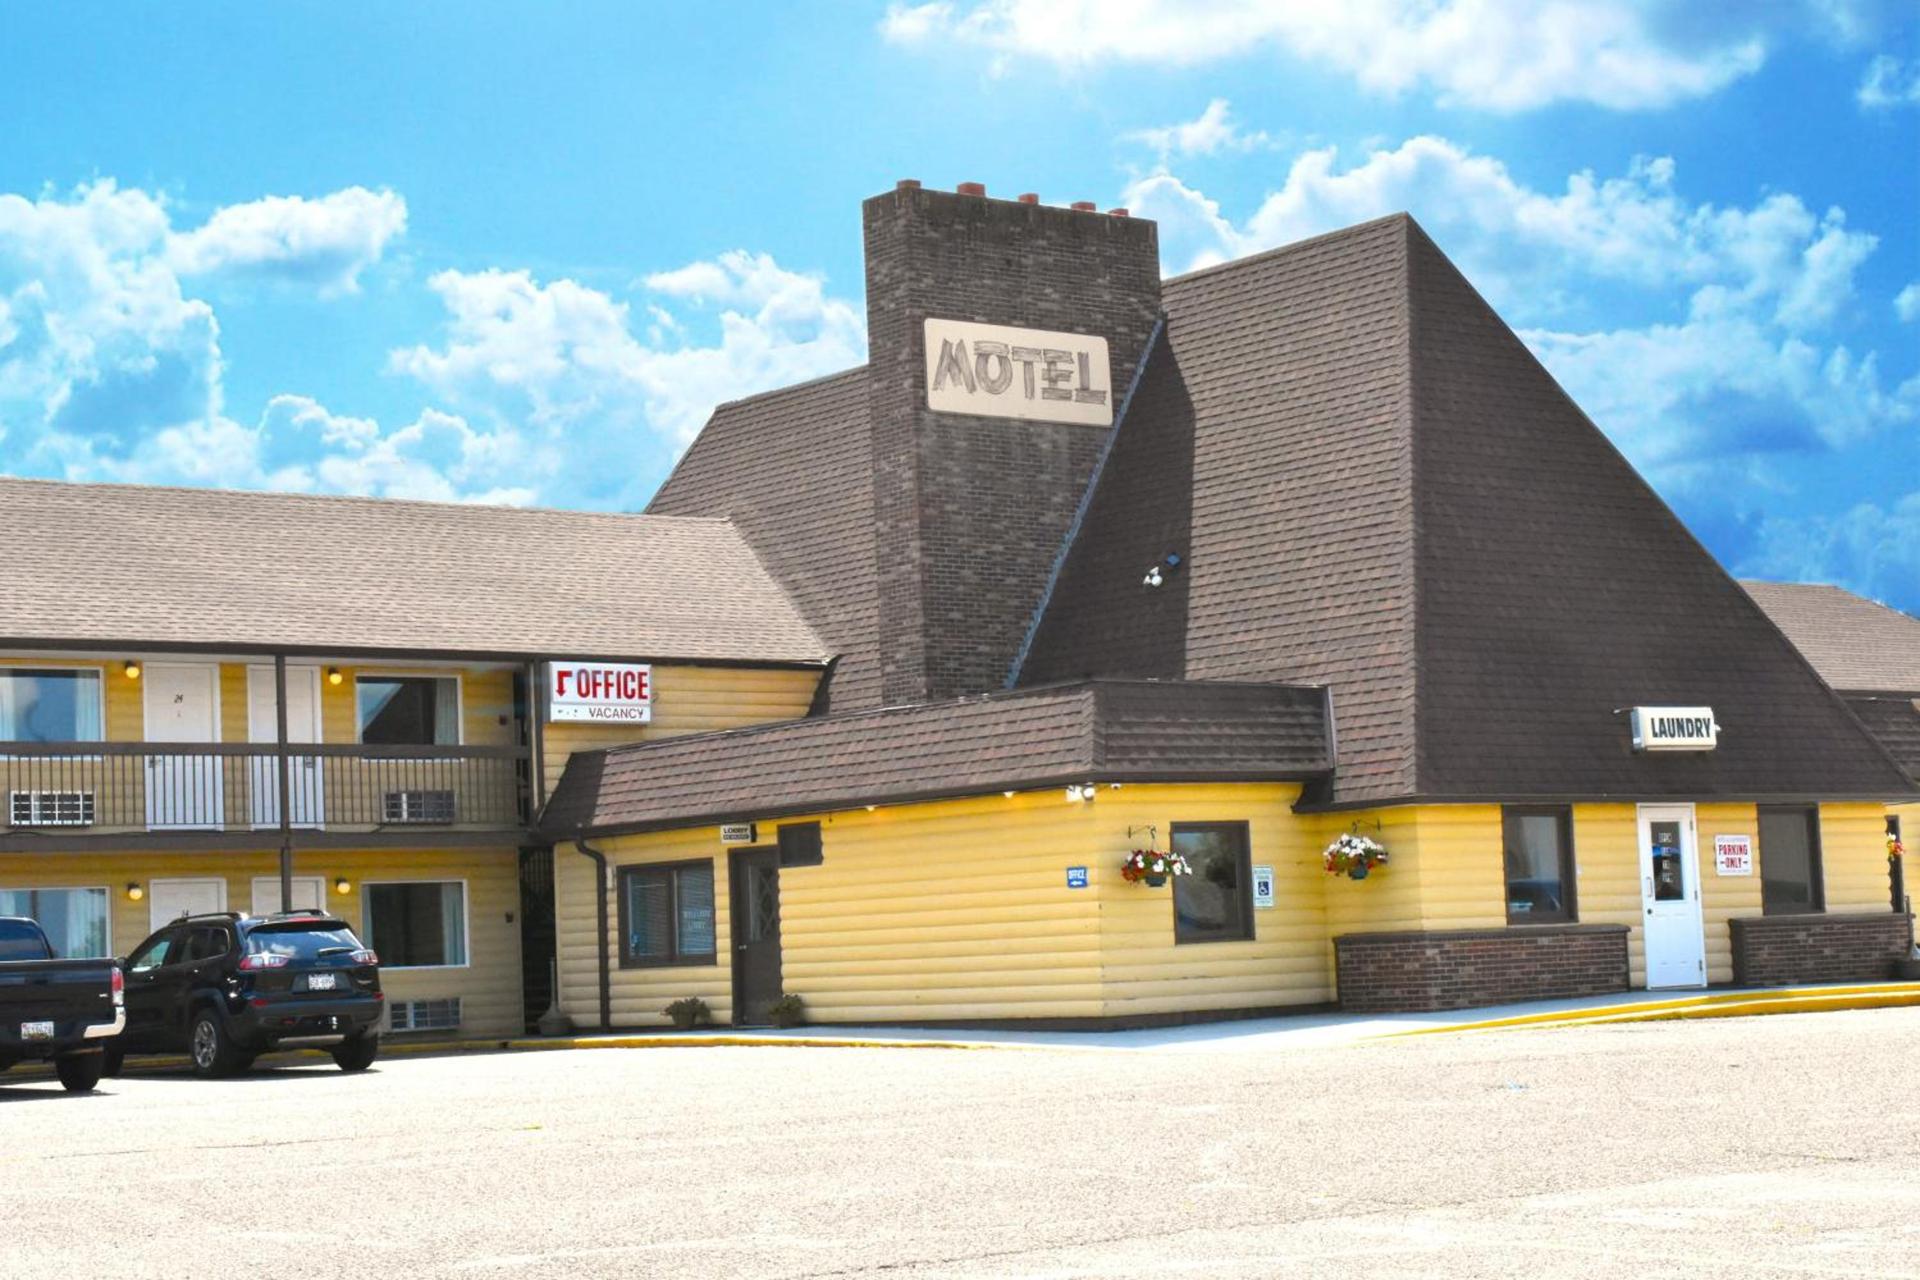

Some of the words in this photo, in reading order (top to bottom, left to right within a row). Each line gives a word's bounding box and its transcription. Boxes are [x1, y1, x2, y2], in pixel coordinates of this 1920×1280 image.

[932, 338, 1107, 405] MOTEL
[577, 668, 648, 700] OFFICE
[588, 707, 644, 719] VACANCY
[1650, 717, 1711, 738] LAUNDRY
[1718, 844, 1748, 855] PARKING
